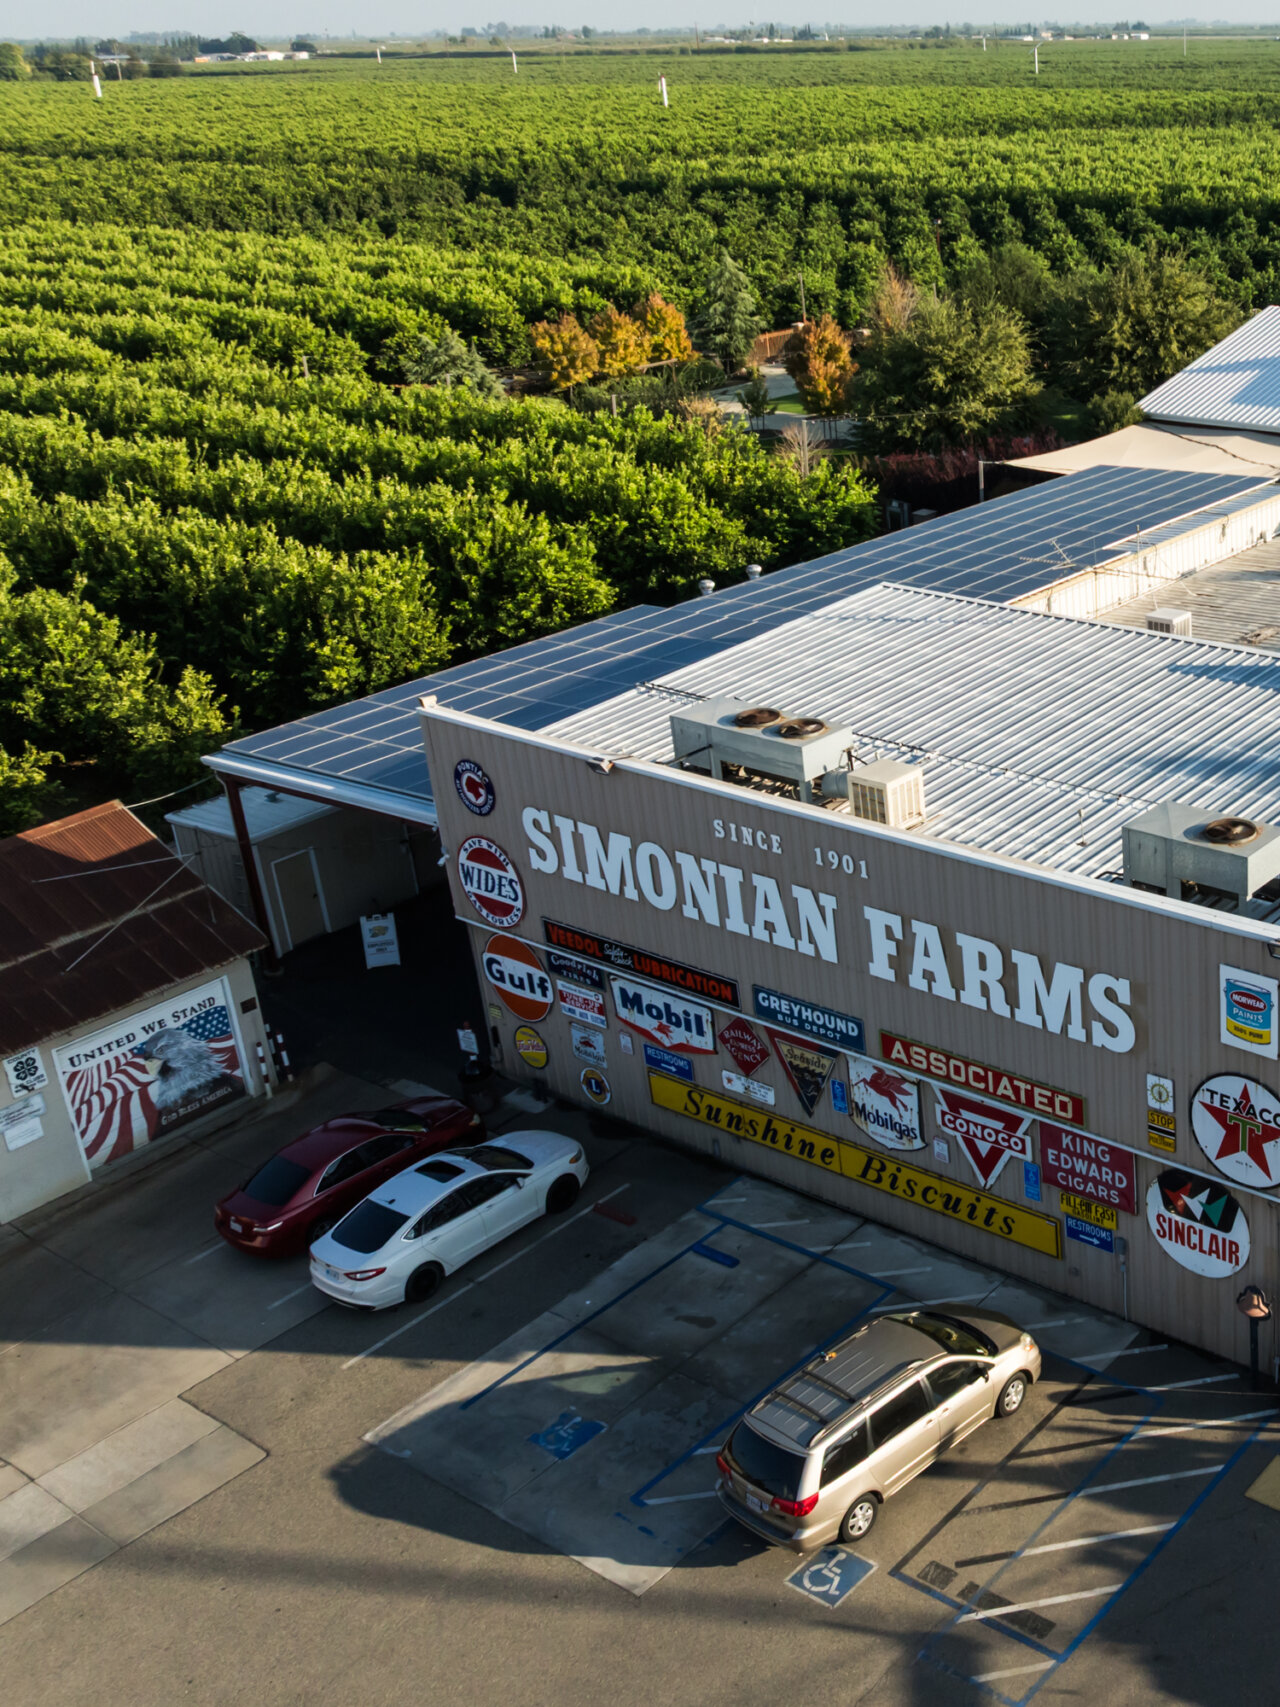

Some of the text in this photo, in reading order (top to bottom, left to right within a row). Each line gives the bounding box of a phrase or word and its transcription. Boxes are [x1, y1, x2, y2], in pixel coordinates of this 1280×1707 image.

[457, 761, 489, 784] PONTIAC
[463, 839, 510, 868] SAVE WITH
[713, 818, 869, 880] SINCE 1901
[460, 862, 519, 902] WIDES
[485, 912, 505, 926] FOR
[506, 906, 522, 926] LESS
[521, 806, 1138, 1055] SIMONIAN FARMS
[546, 922, 603, 957] VEEDOL
[633, 953, 733, 1001] LUBRICATION
[550, 953, 599, 980] Goodrich
[485, 957, 549, 999] Gulf
[562, 991, 600, 1008] TUNE-UP
[566, 998, 600, 1014] SERVICE
[619, 986, 705, 1038] Mobil
[758, 991, 859, 1038] GREYHOUND
[1232, 993, 1265, 1010] MORWEAR
[1233, 1007, 1264, 1023] PAINTS
[68, 996, 217, 1068] UNITED WE STAND
[723, 1029, 763, 1050] RAILWAY
[777, 1012, 841, 1041] BUS DEPOT
[7, 1049, 36, 1064] COUNTY
[647, 1047, 689, 1069] RESTROOMS
[725, 1043, 761, 1064] AGENCY
[785, 1047, 827, 1071] Seaside
[590, 1079, 601, 1094] L
[890, 1041, 1073, 1119] ASSOCIATED
[178, 1102, 200, 1118] BLESS
[201, 1086, 233, 1106] AMERICA
[854, 1101, 918, 1140] Mobilgas
[943, 1113, 1023, 1151] CONOCO
[1150, 1112, 1173, 1128] STOP
[1227, 1112, 1262, 1153] T
[682, 1089, 836, 1166] Sunshine
[855, 1153, 1016, 1237] Biscuits
[1061, 1132, 1111, 1163] KING
[1047, 1148, 1128, 1189] EDWARD
[1056, 1172, 1120, 1204] CIGARS
[1067, 1217, 1112, 1241] RESTROOMS
[1155, 1213, 1241, 1267] SINCLAIR
